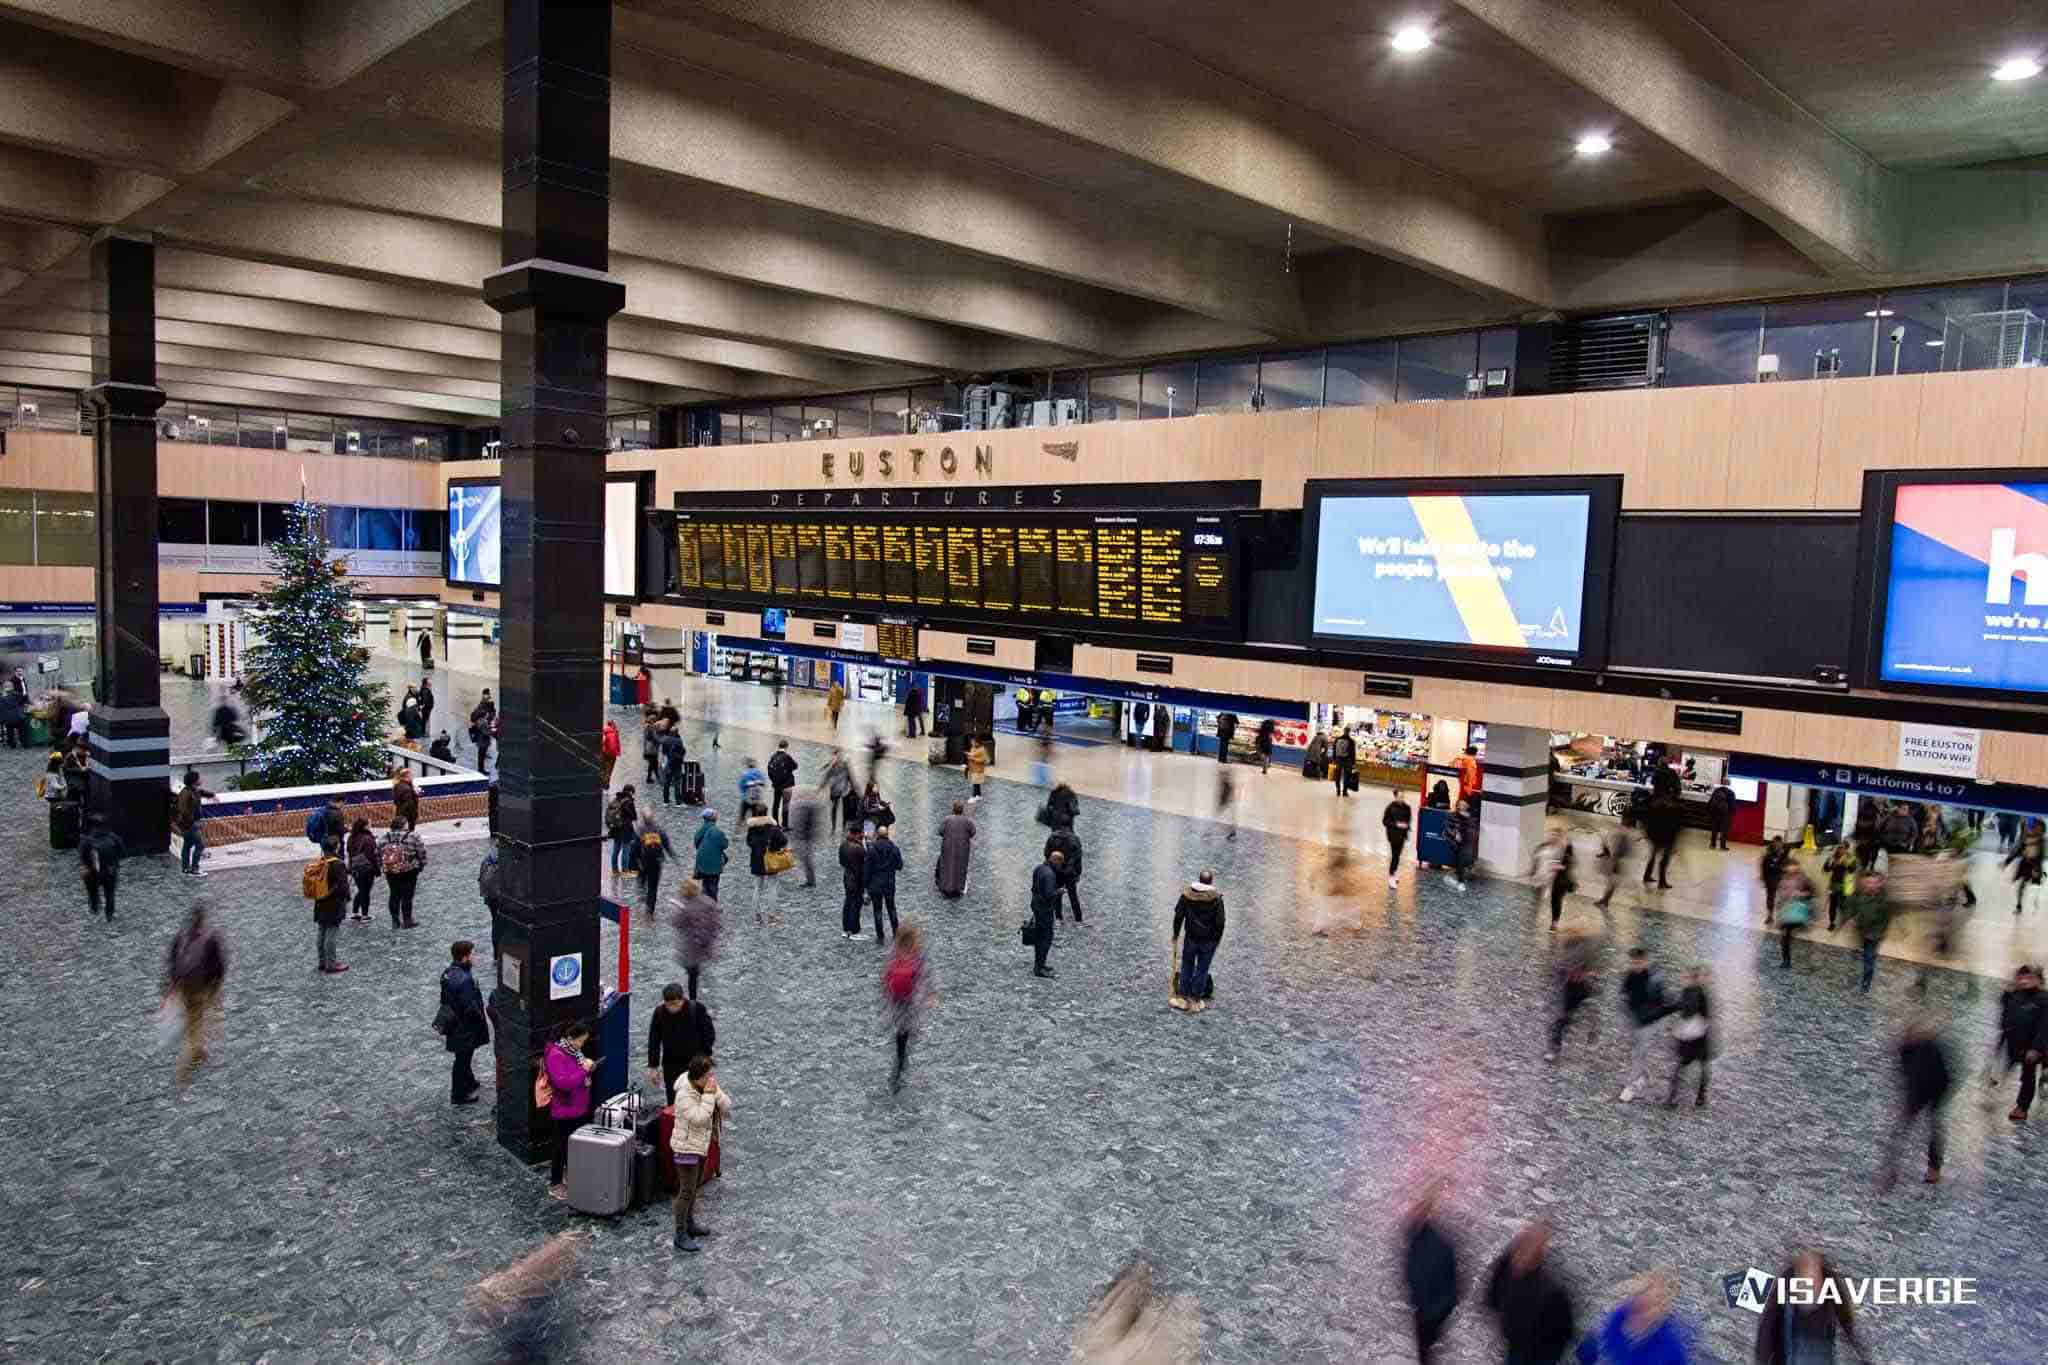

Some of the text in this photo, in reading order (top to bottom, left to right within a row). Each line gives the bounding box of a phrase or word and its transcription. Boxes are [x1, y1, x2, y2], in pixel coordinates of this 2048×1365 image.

[821, 445, 994, 479] EUSTON
[770, 489, 1064, 507] DEPARTURES
[1984, 613, 2041, 630] we're
[1904, 736, 1974, 752] FREE EUSTON
[1904, 748, 1947, 761] STATION
[1857, 773, 1966, 796] Platforms 4 to 7
